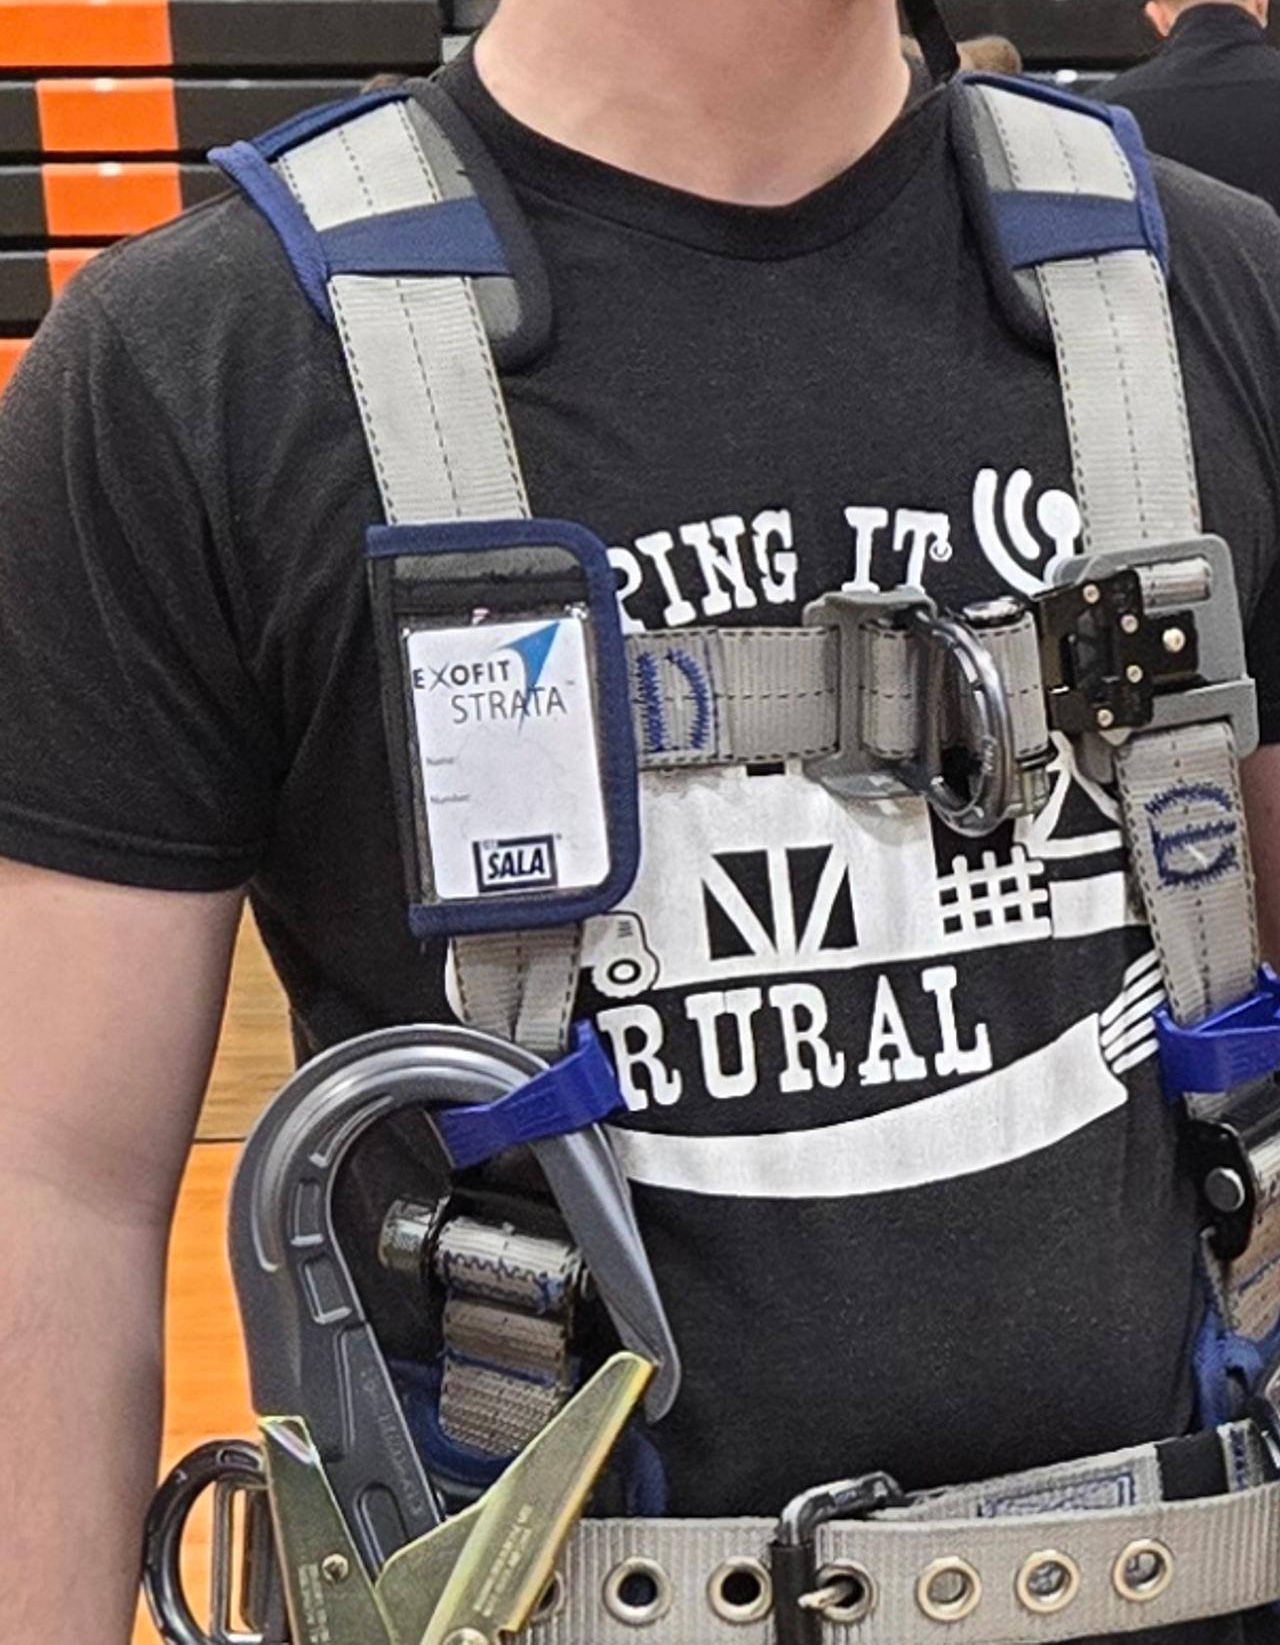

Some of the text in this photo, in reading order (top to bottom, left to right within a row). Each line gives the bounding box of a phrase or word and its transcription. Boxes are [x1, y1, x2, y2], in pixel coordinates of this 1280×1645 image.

[606, 506, 952, 635] PING IT
[413, 659, 511, 692] EXOFIT
[452, 686, 568, 725] STRATA
[487, 846, 546, 881] SALA
[597, 965, 993, 1112] RURAL
